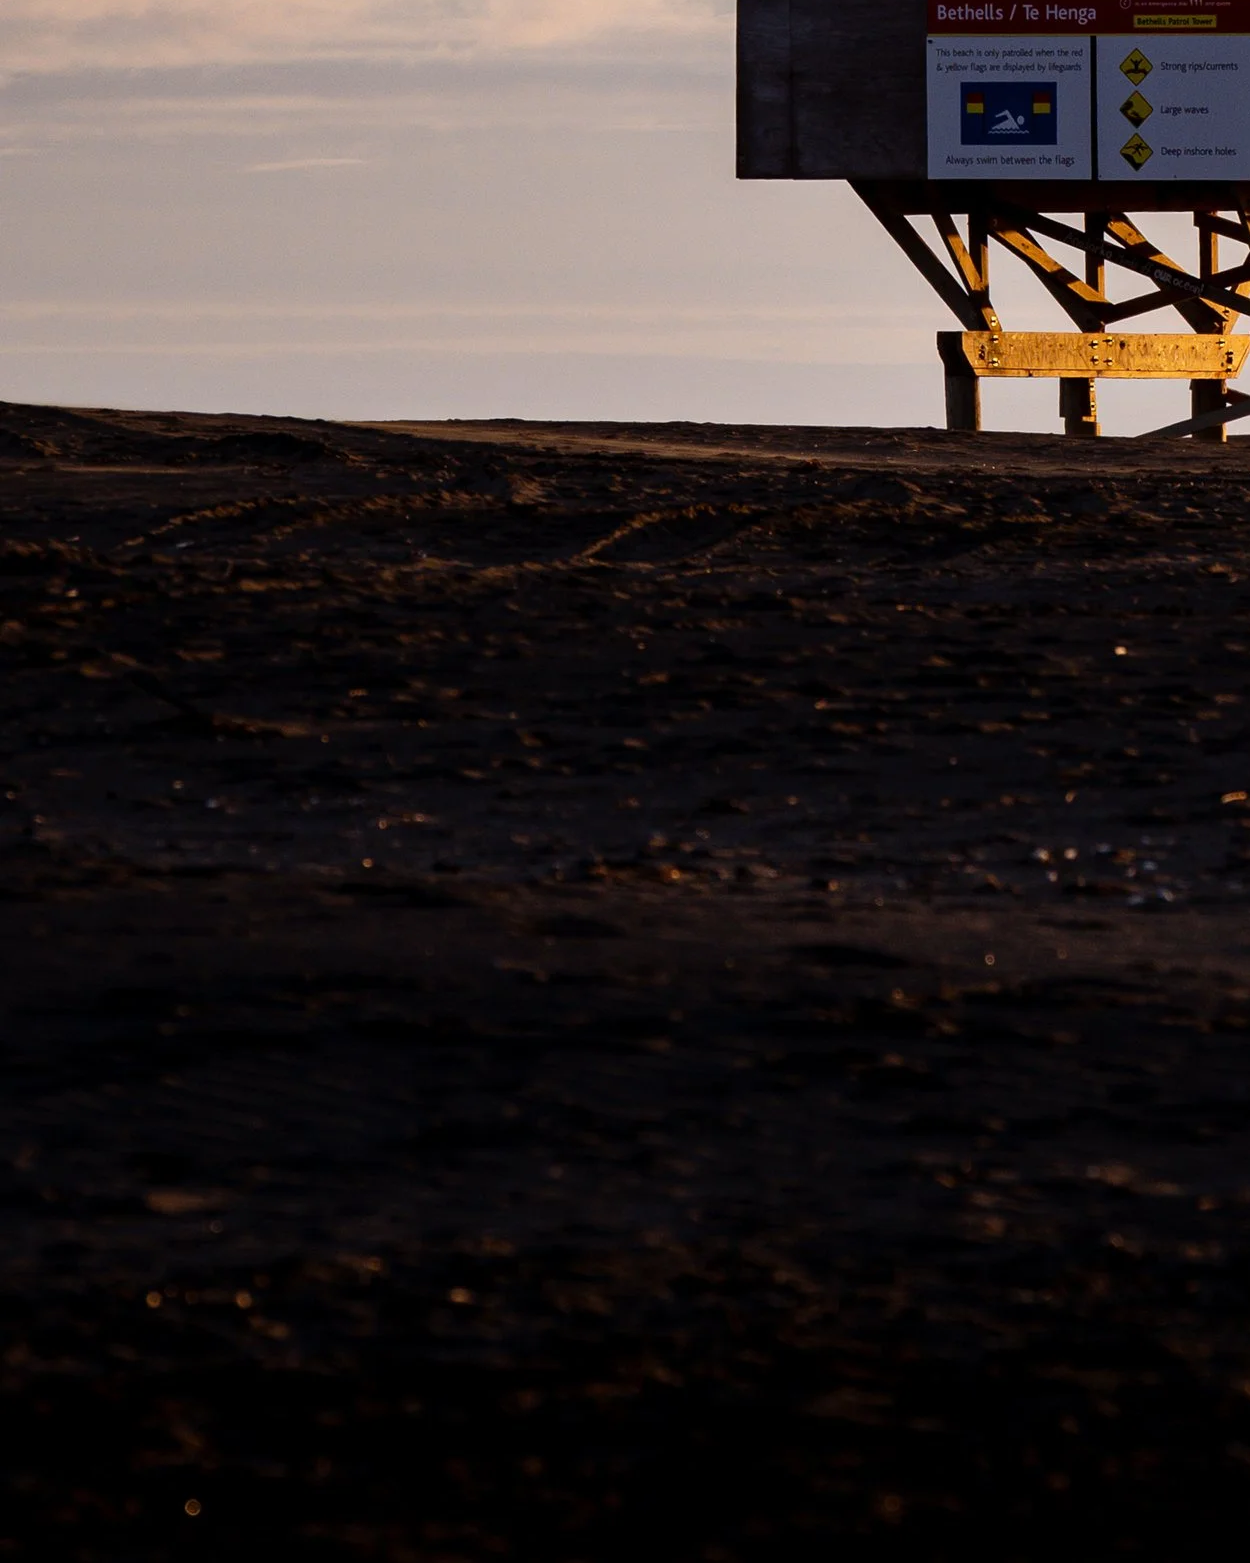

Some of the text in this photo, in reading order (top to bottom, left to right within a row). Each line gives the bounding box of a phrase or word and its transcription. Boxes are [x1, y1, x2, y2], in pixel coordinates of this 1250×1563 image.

[937, 3, 1004, 20] Bethells
[1022, 4, 1040, 20] Te
[1046, 4, 1097, 25] Henga
[1137, 17, 1214, 26] Bethells Patrol Tower
[936, 48, 1083, 60] This beach is only patrolled when the red
[945, 63, 969, 74] yellow
[970, 63, 987, 74] flags
[989, 64, 1001, 72] are
[1002, 63, 1035, 74] displayed
[1037, 63, 1046, 74] by
[1048, 63, 1082, 74] lifeguards
[1160, 61, 1239, 74] Strong rips/currents
[1160, 105, 1209, 117] Large waves
[1160, 146, 1237, 158] Deep inshore holes
[945, 155, 1076, 167] Always swim between the flags
